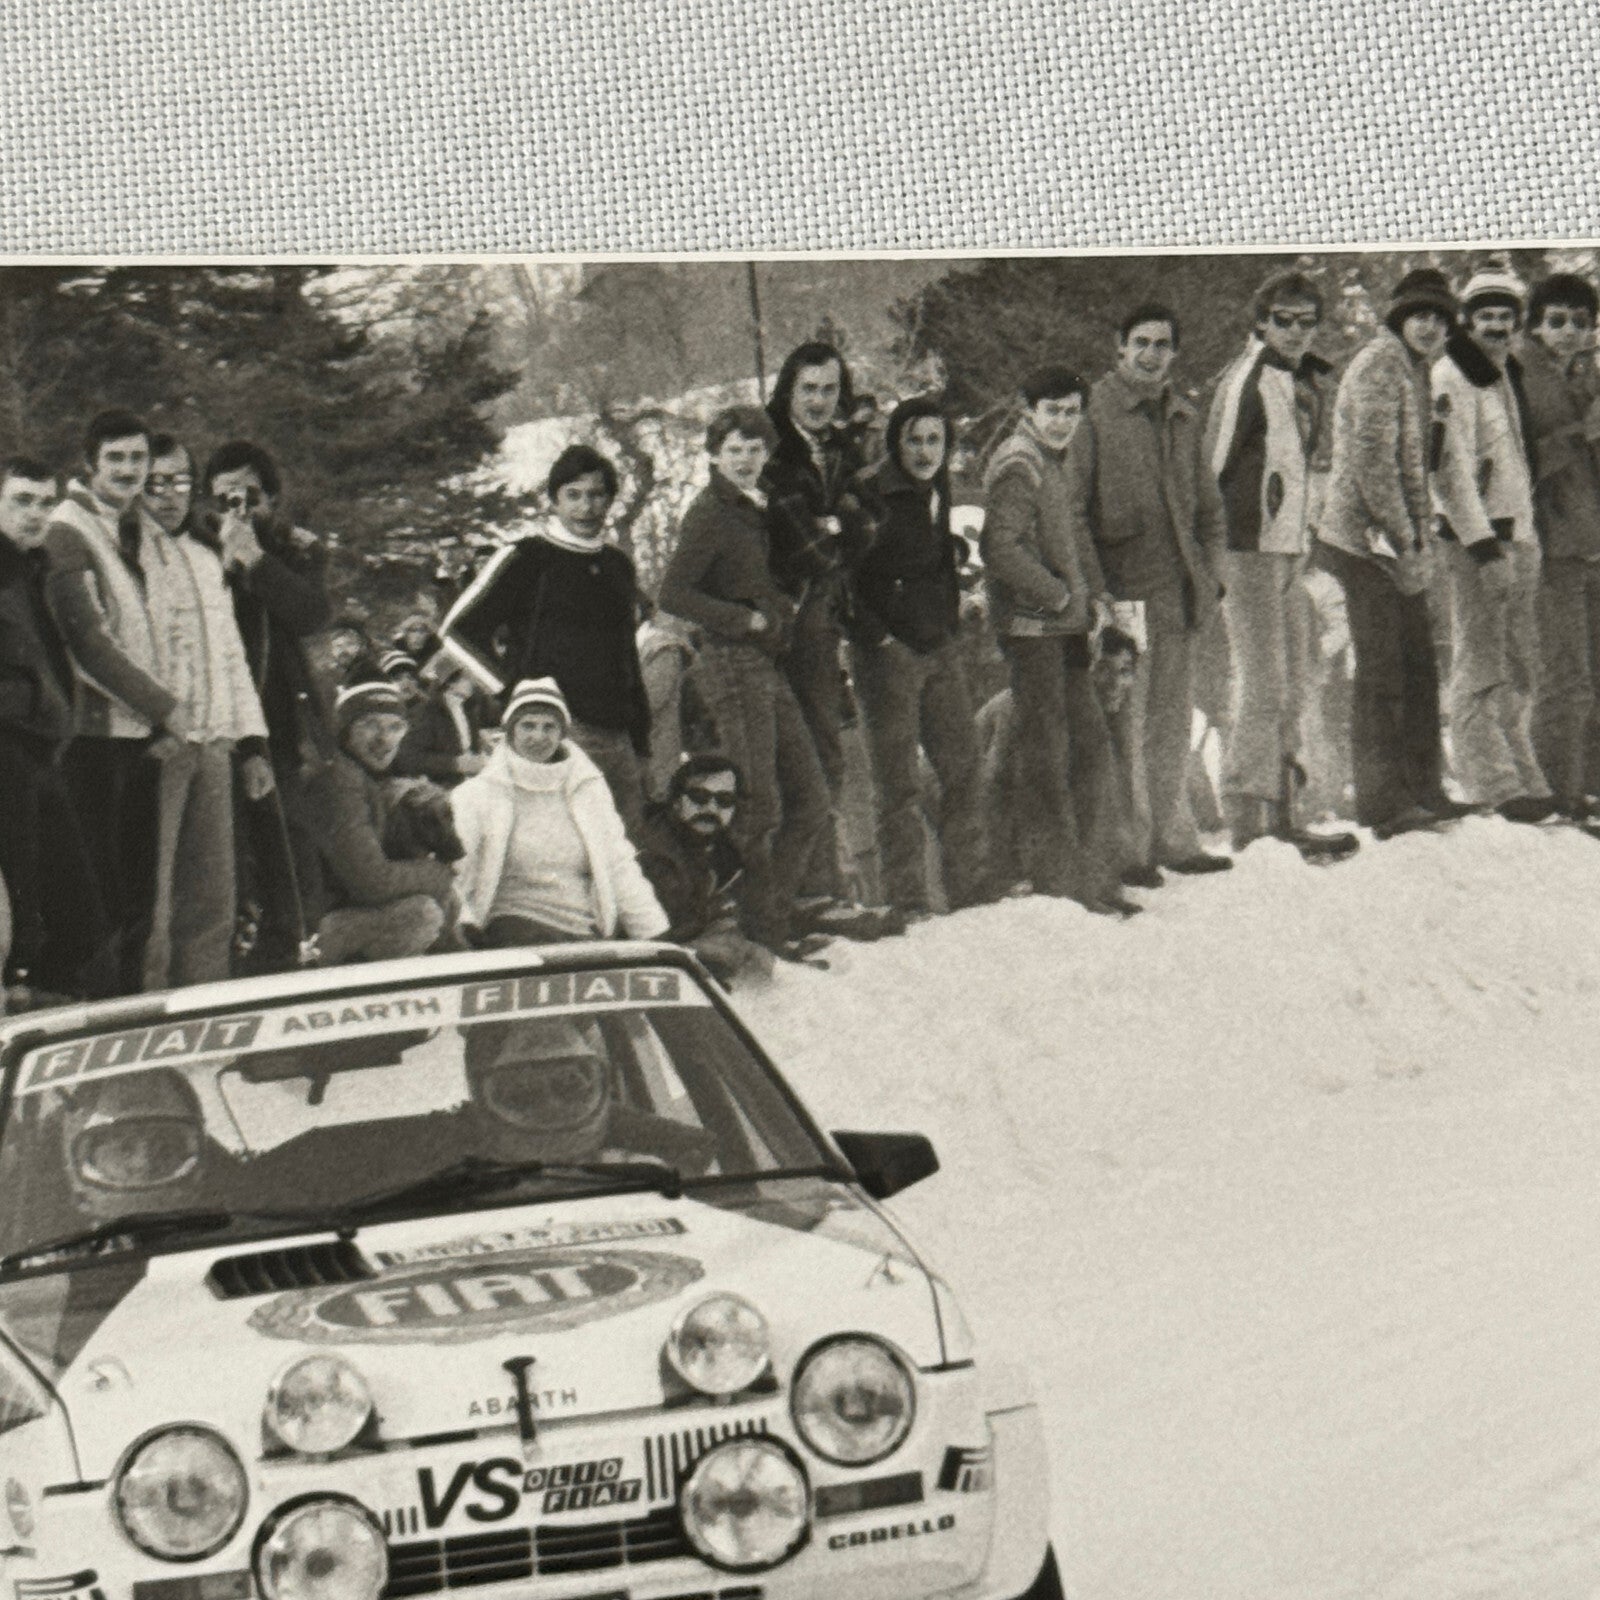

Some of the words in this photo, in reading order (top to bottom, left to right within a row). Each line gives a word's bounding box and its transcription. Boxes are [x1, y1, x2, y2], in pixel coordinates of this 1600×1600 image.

[42, 1019, 253, 1079] FIAT
[282, 996, 441, 1034] ABARTH
[474, 974, 668, 1012] FIAT
[354, 1263, 595, 1326] FIAT
[468, 1387, 578, 1417] ABARTH
[416, 1456, 525, 1530] VS
[525, 1459, 620, 1490] OLIO
[547, 1480, 637, 1512] FIAT
